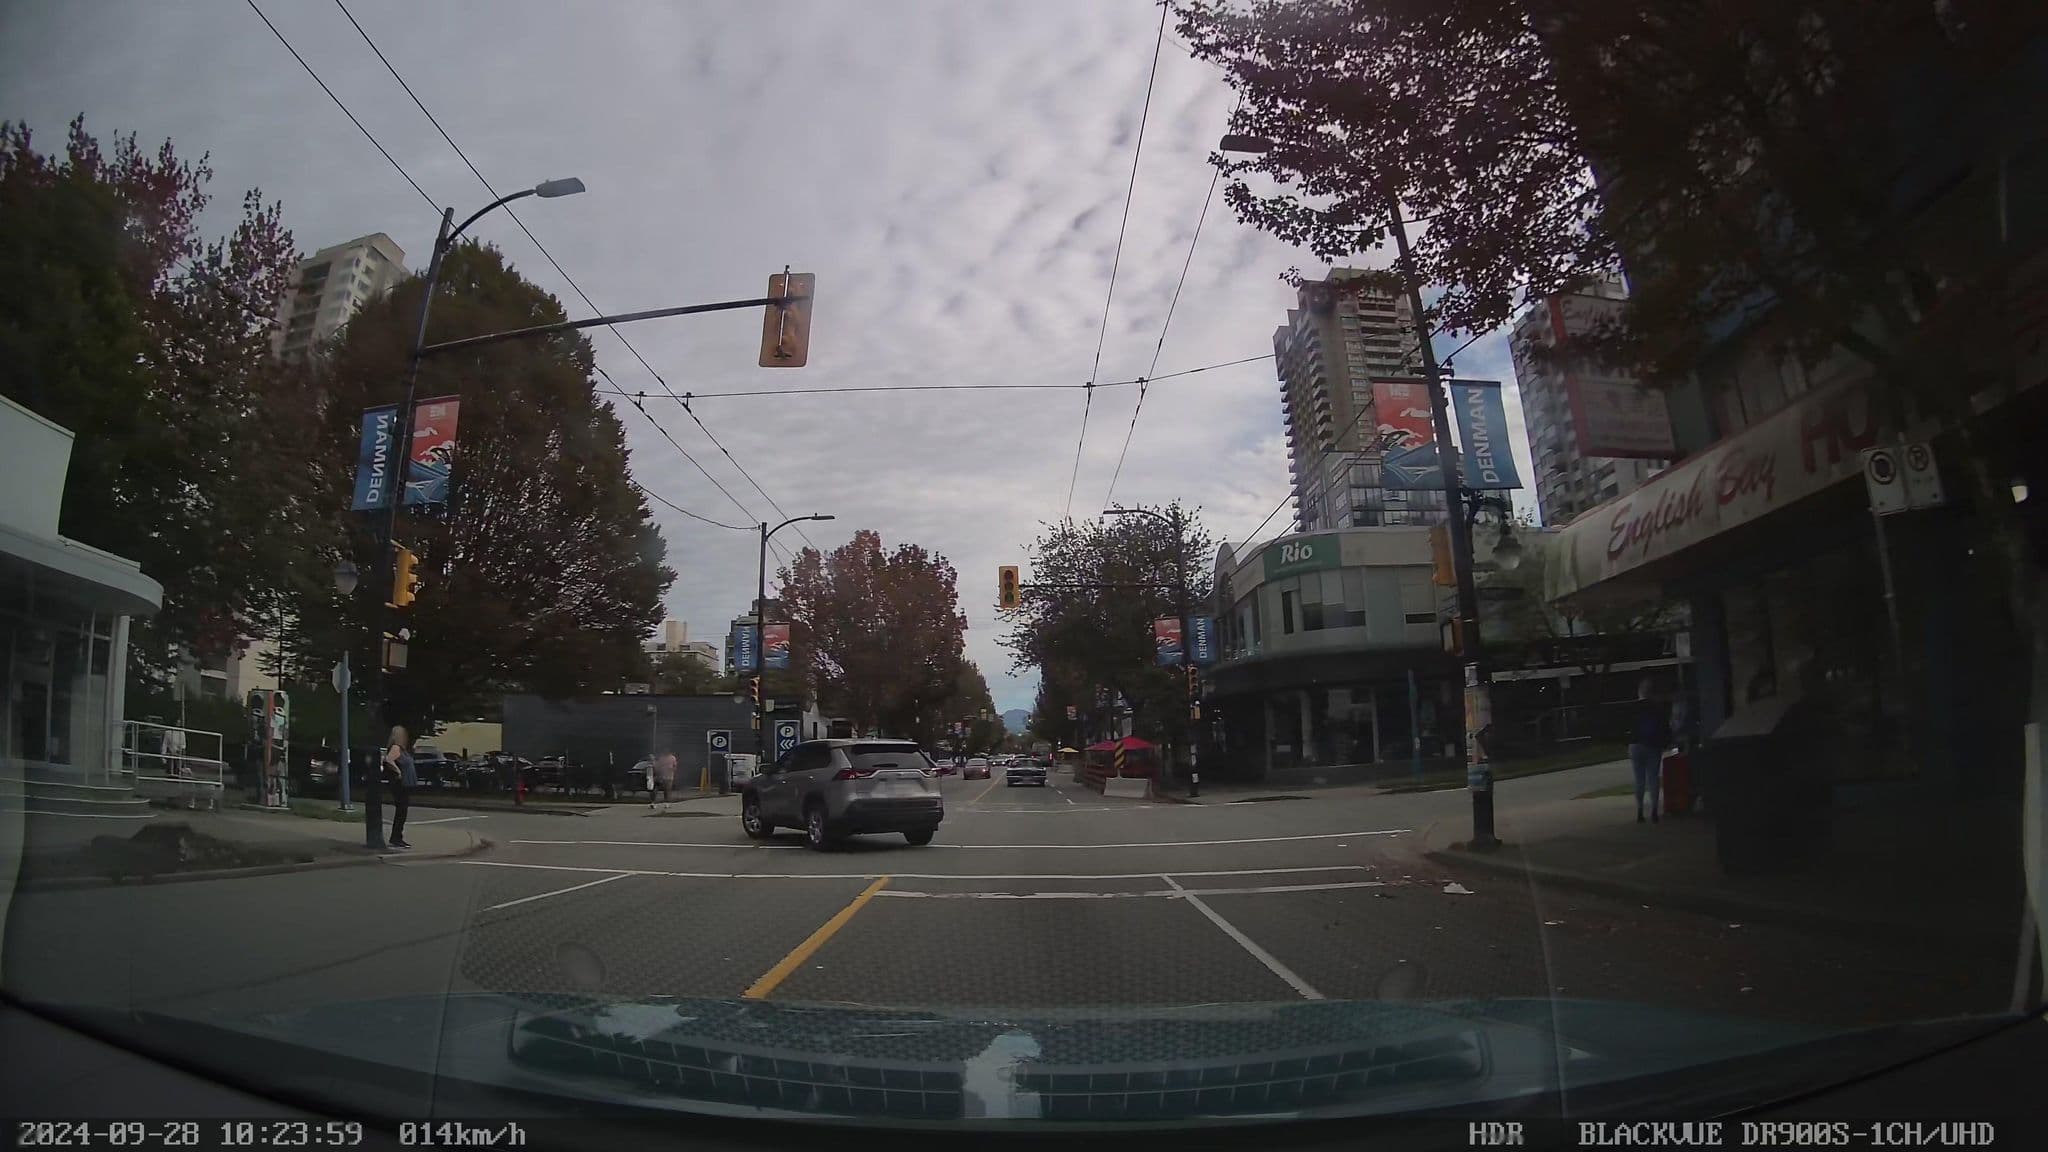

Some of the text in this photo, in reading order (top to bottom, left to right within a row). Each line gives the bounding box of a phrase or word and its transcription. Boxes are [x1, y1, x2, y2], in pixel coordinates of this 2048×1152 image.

[1468, 387, 1500, 483] DENMAN
[1607, 466, 1705, 561] English
[1717, 447, 1776, 505] Bay
[1280, 541, 1313, 564] Rio
[1196, 618, 1208, 659] DENMAN
